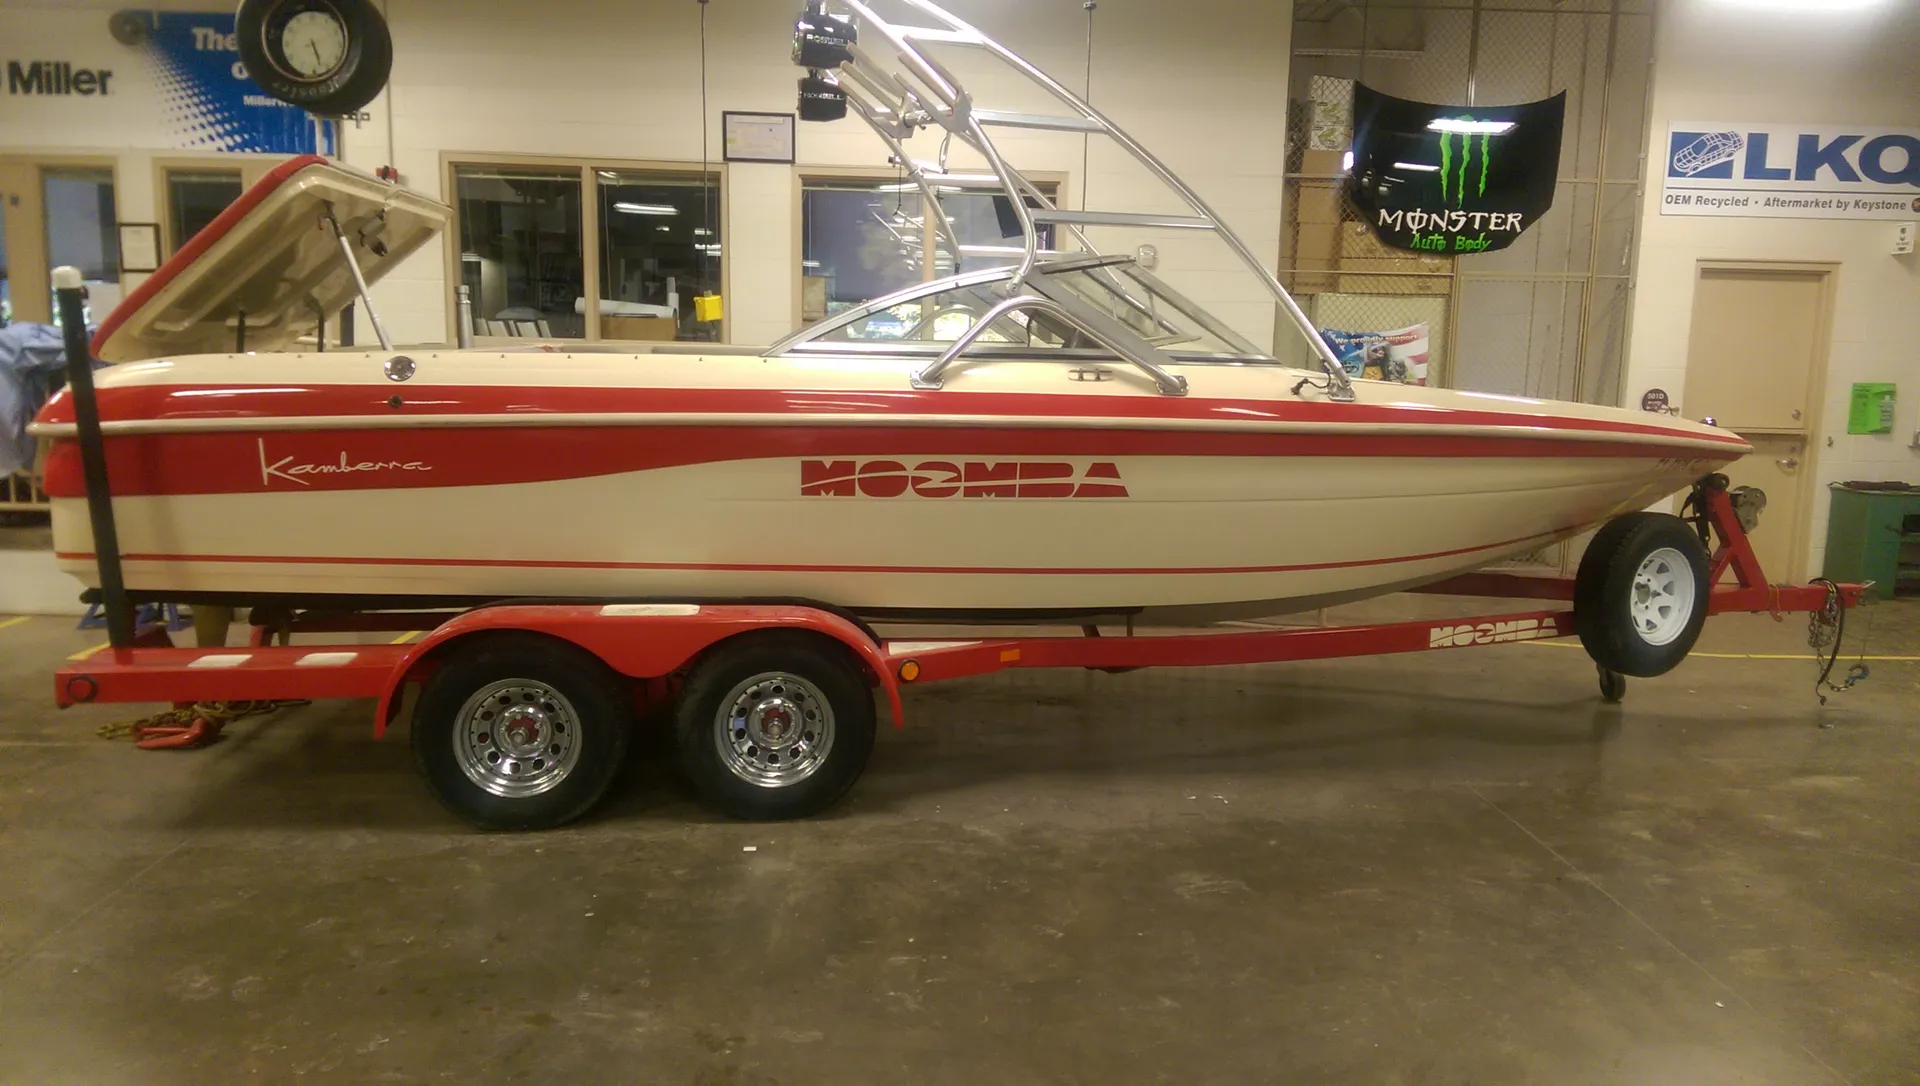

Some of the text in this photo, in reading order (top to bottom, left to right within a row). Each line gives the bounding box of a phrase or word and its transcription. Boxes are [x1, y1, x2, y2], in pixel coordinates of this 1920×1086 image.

[8, 61, 113, 95] Miller
[1743, 132, 1920, 188] LKQ
[1665, 194, 1907, 212] OEM Recycled Aftermarket by Keystone
[1335, 337, 1348, 345] We
[1385, 334, 1417, 344] support
[258, 437, 432, 486] Kamberra
[801, 460, 1130, 498] MOOMBA
[1429, 617, 1559, 648] MOOMBA
